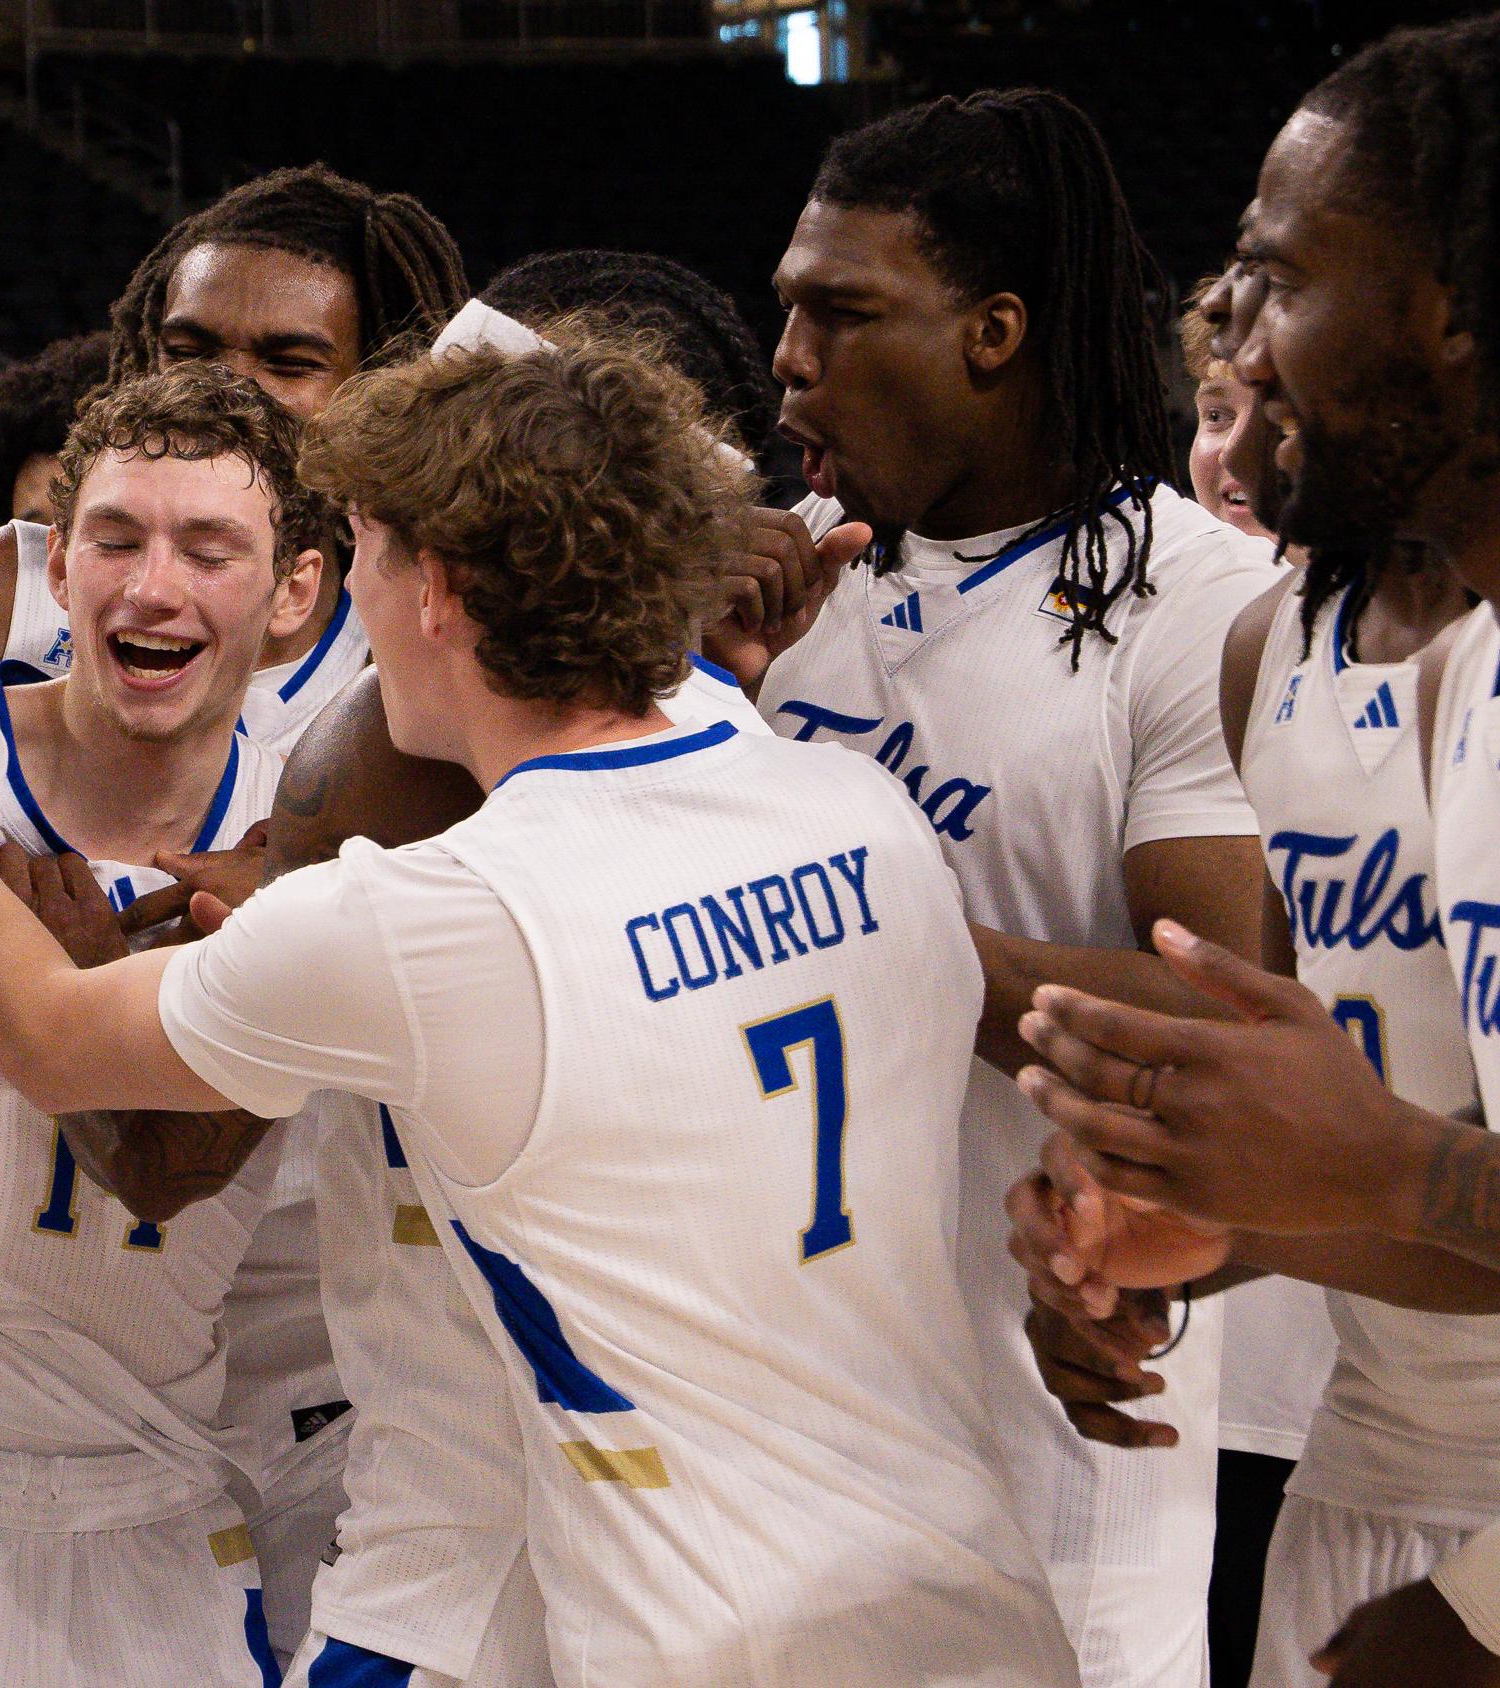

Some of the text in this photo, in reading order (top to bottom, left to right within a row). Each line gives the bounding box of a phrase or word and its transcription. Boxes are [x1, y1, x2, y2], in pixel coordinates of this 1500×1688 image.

[776, 700, 992, 842] Tlsa
[625, 845, 879, 1002] CONROY
[1268, 828, 1448, 951] Tuls
[739, 993, 856, 1265] 7
